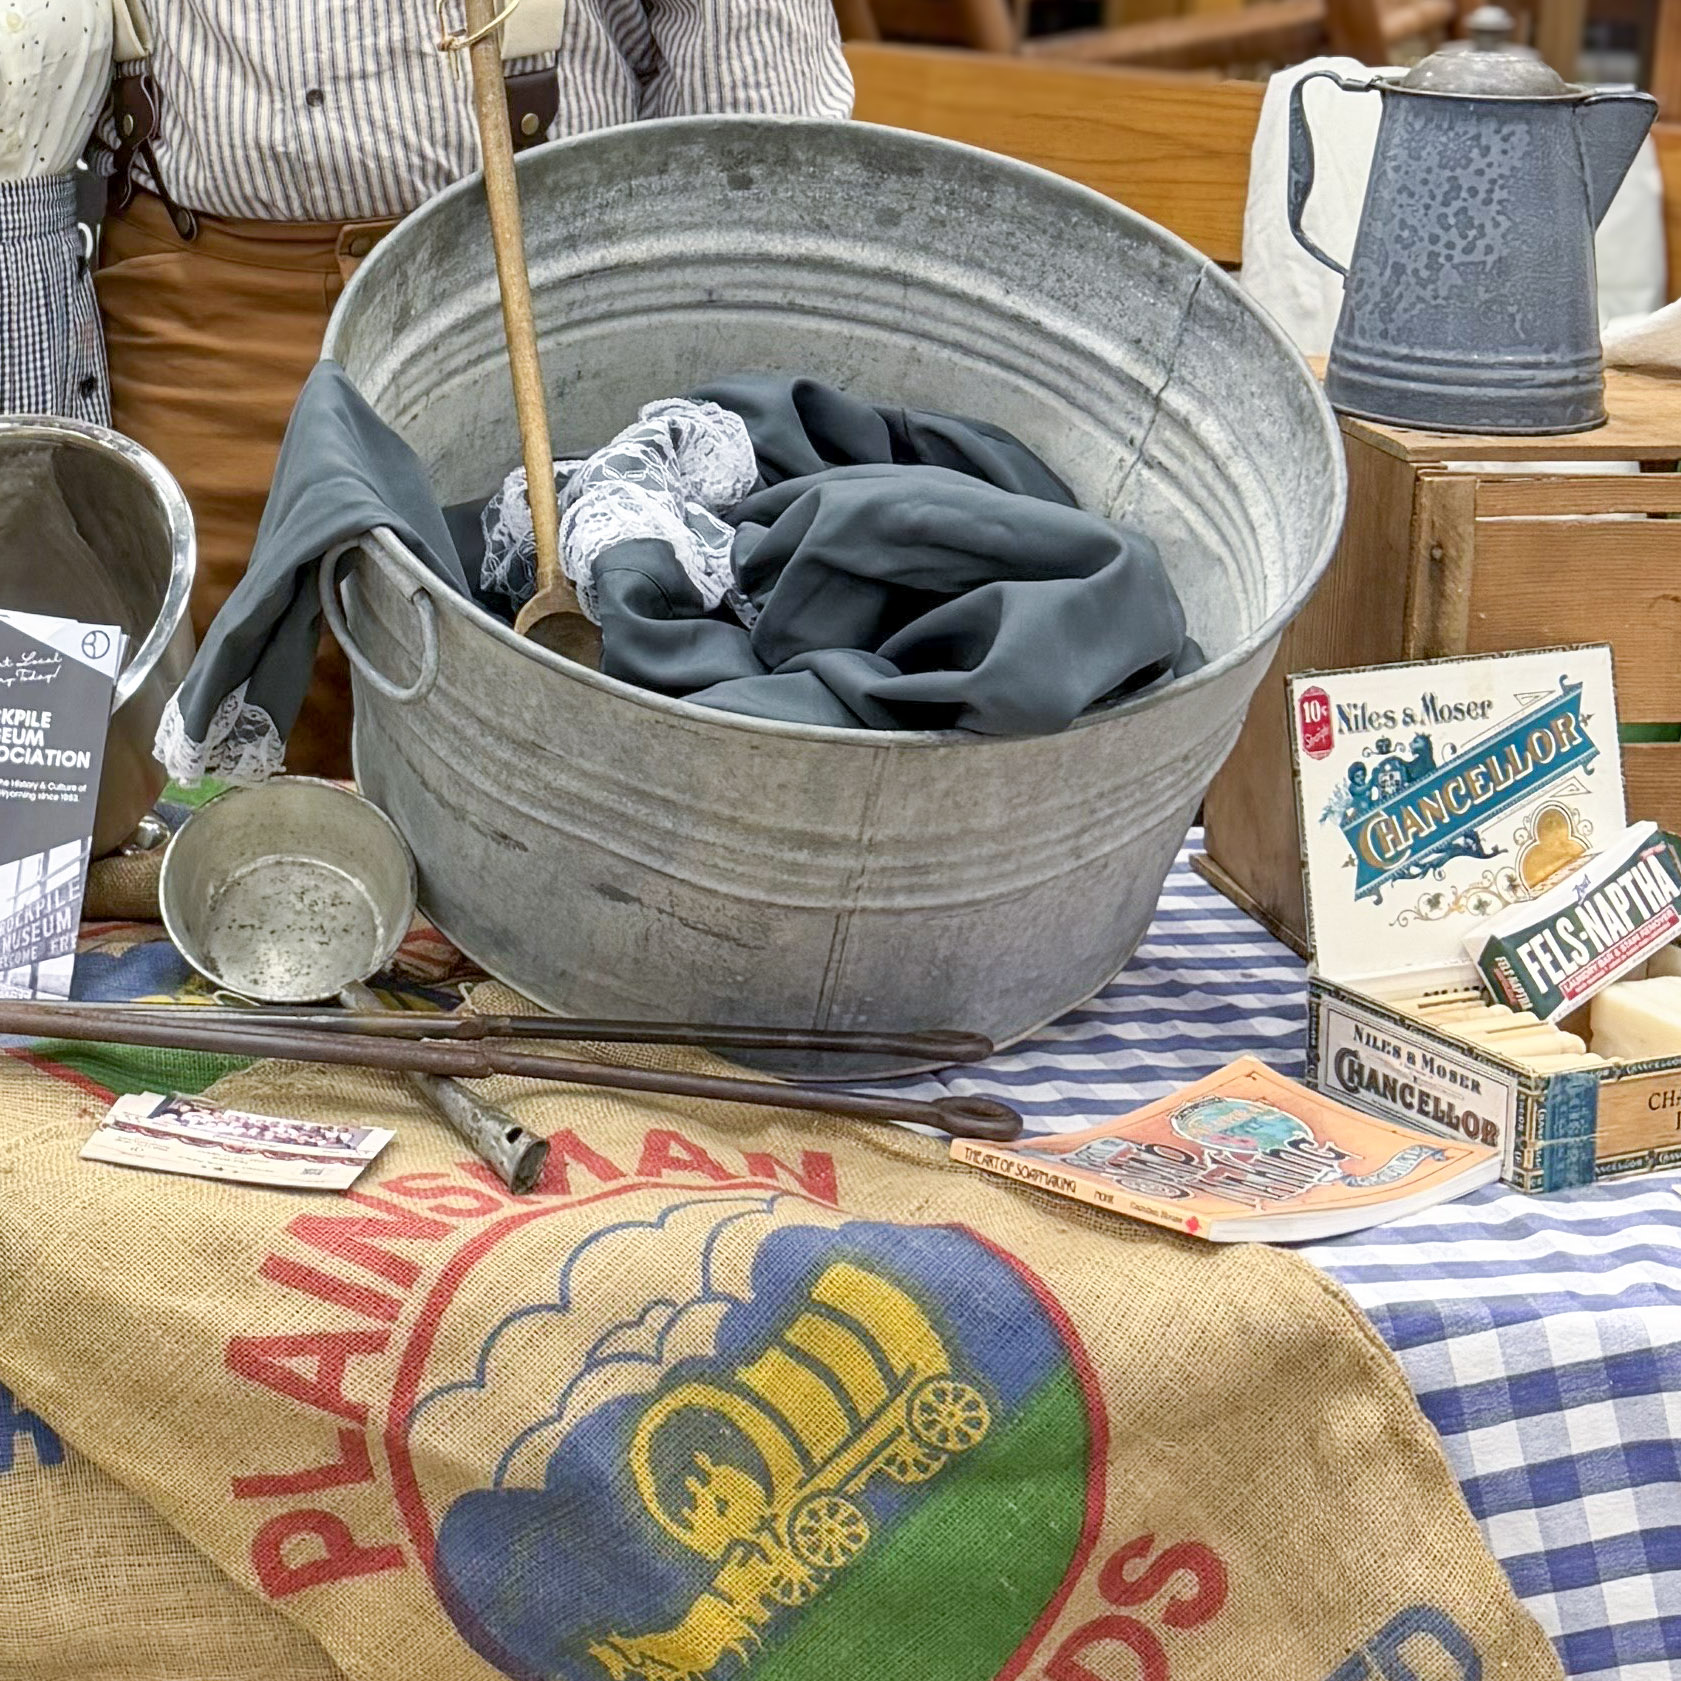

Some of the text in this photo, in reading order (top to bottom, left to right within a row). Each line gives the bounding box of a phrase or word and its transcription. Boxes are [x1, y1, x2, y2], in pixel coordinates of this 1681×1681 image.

[1336, 702, 1398, 735] Niles
[1421, 691, 1494, 726] Moser
[1357, 710, 1583, 870] CHANCELLOR
[0, 880, 81, 936] ROCKPILE
[2, 905, 72, 954] MUSEUM
[1516, 854, 1681, 995] FELS-NAPTHA
[1353, 1023, 1402, 1059] NILES
[1421, 1052, 1482, 1096] MOSER
[1334, 1047, 1499, 1148] CHANCELLOR
[964, 1146, 984, 1166] THE
[983, 1152, 1001, 1172] ART
[224, 1128, 838, 1600] PLAINSMAN
